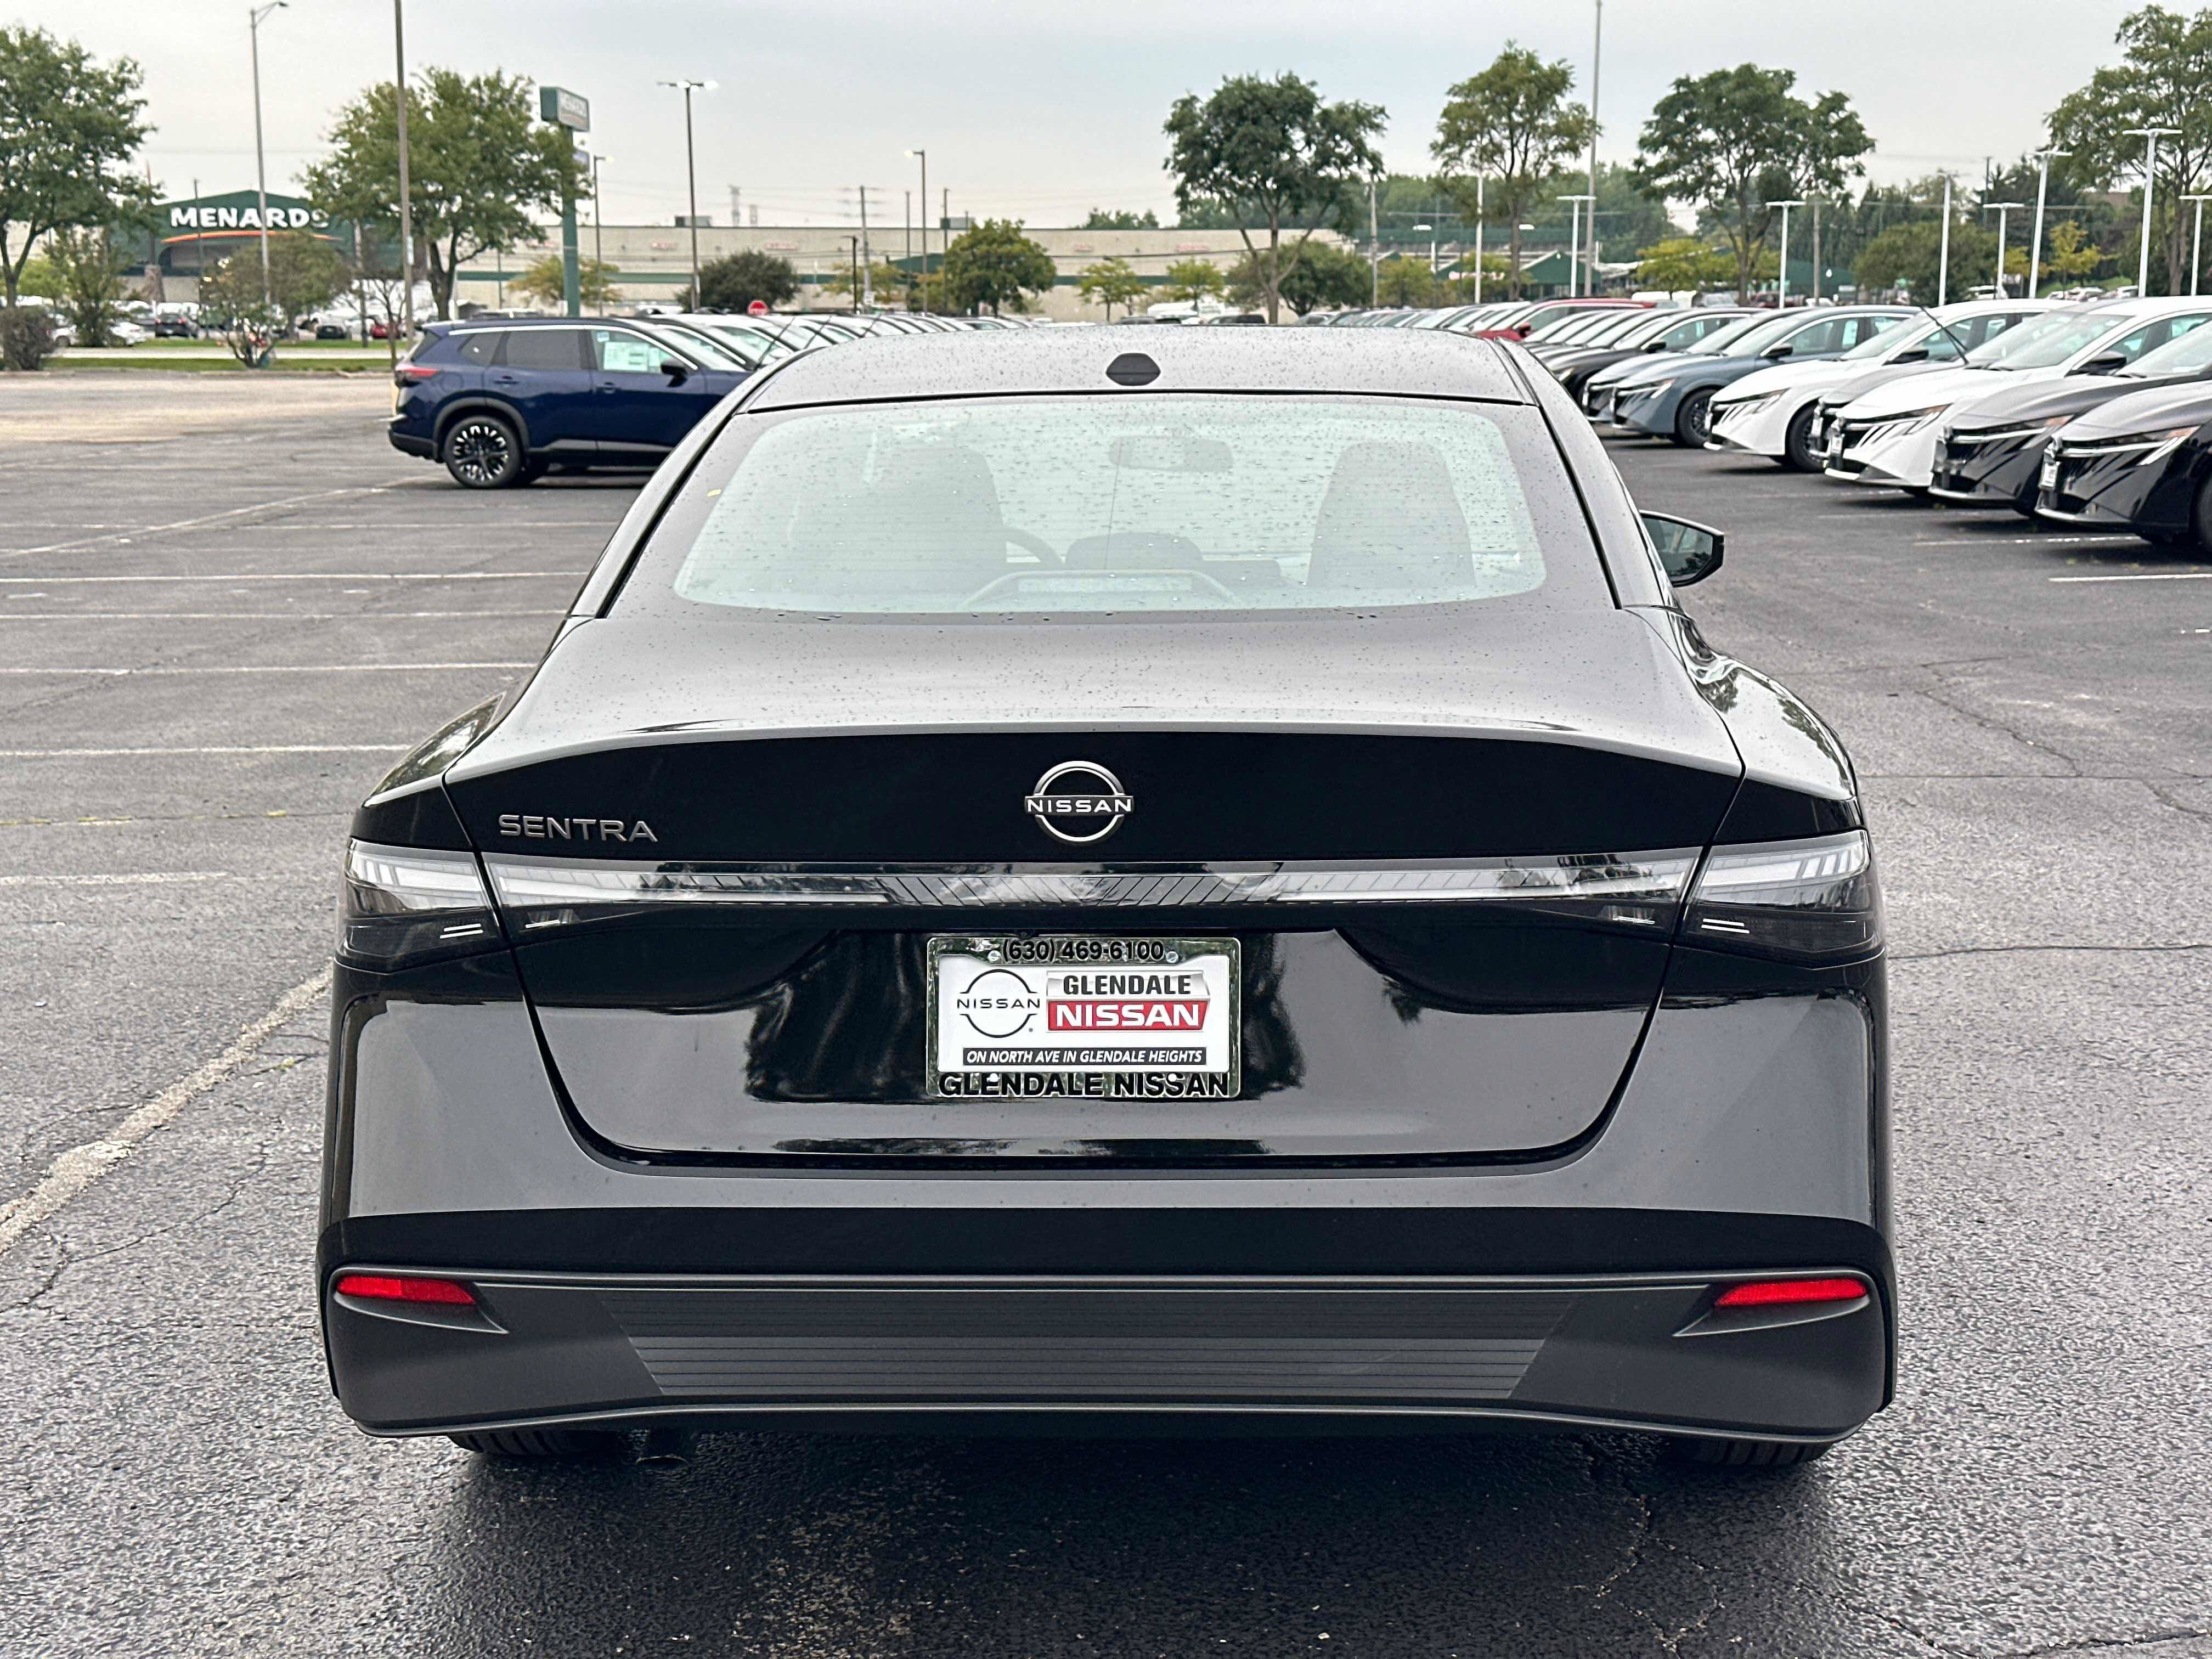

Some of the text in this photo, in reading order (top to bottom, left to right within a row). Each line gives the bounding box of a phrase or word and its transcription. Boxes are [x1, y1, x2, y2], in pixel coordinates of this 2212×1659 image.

[171, 207, 329, 228] MENARDS
[1027, 798, 1131, 813] NISSAN
[498, 814, 658, 842] SENTRA
[1003, 939, 1164, 963] (630) 469-6100
[1063, 975, 1191, 995] GLENDALE
[957, 998, 1040, 1009] NISSAN
[1056, 1004, 1199, 1027] NISSAN
[967, 1049, 1203, 1063] ON NORTH AVE IN GLENDALE HEIGHTS
[938, 1072, 1228, 1097] GLENDALE NISSAN
